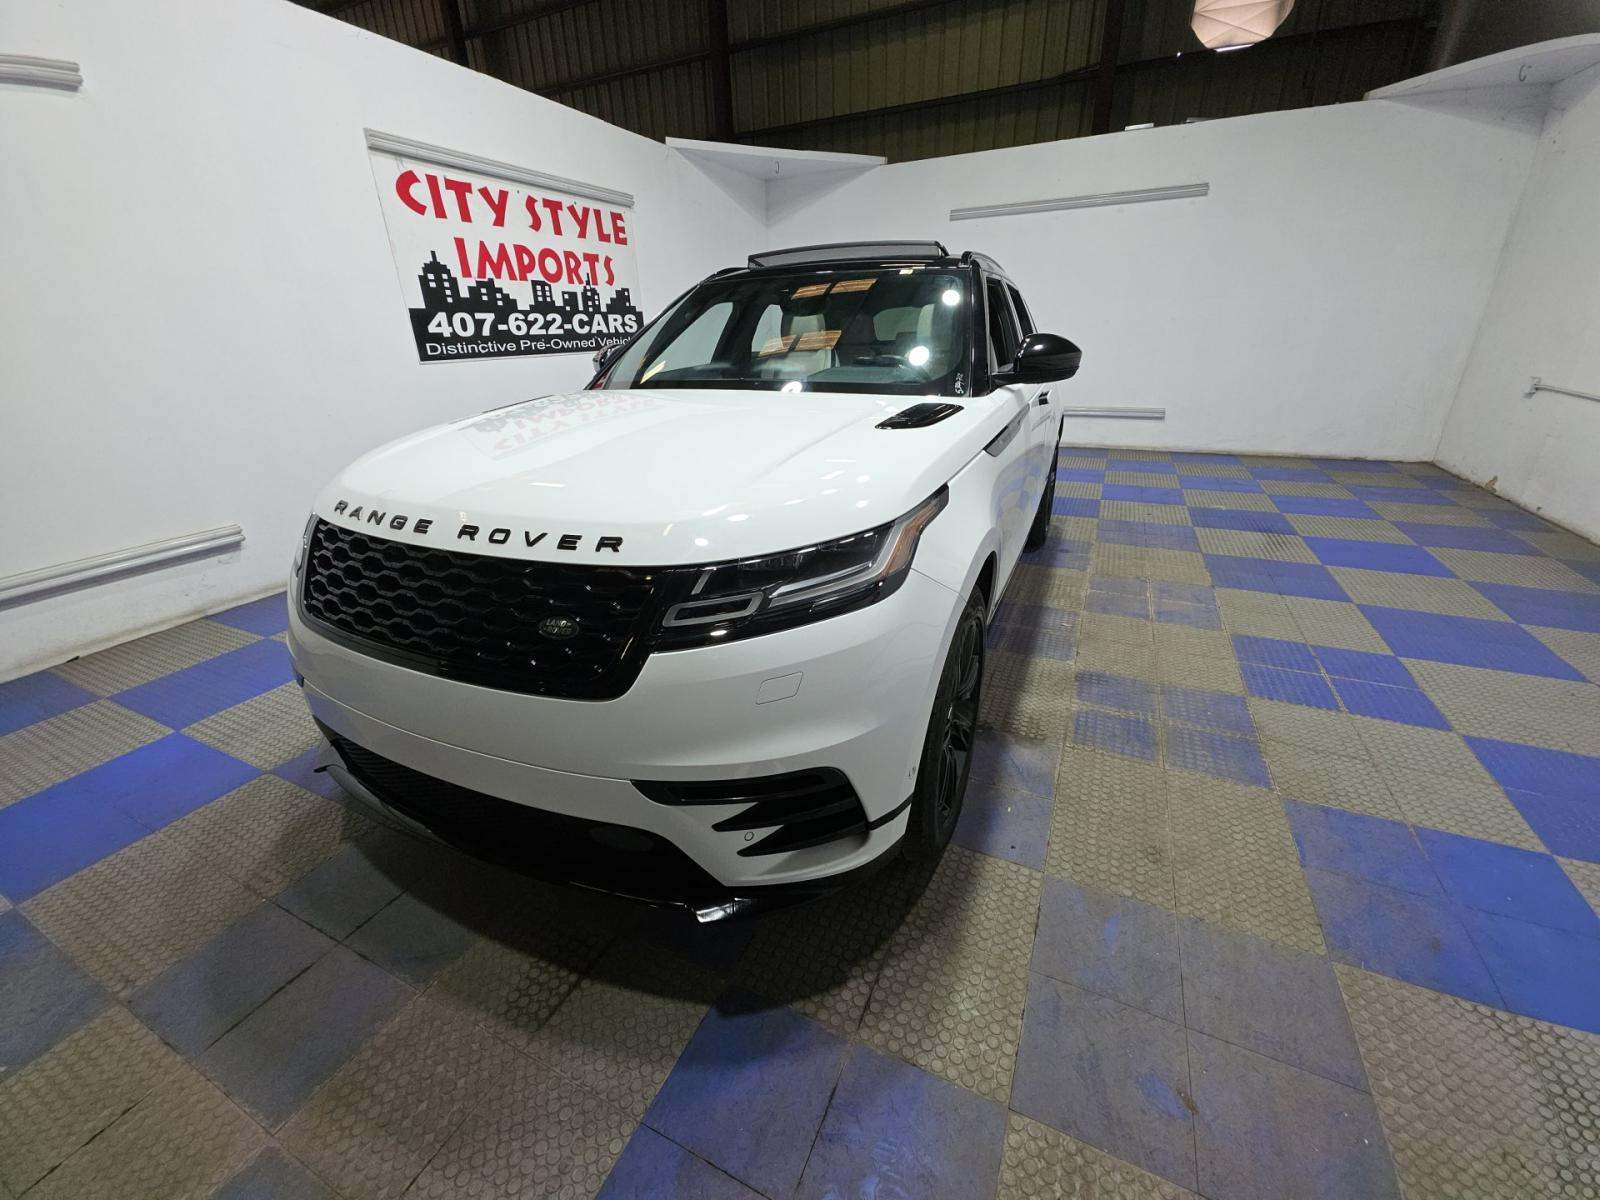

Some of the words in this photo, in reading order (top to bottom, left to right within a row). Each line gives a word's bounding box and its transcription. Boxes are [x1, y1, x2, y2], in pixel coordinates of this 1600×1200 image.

[395, 169, 509, 227] CITY
[525, 195, 628, 246] STYLE
[453, 237, 615, 287] IMPORTS
[425, 340, 516, 356] Distinctive
[520, 338, 596, 352] Pre-Owned
[427, 311, 638, 338] 407-622-CARS
[334, 500, 434, 535] RANGE
[457, 524, 624, 553] ROVER
